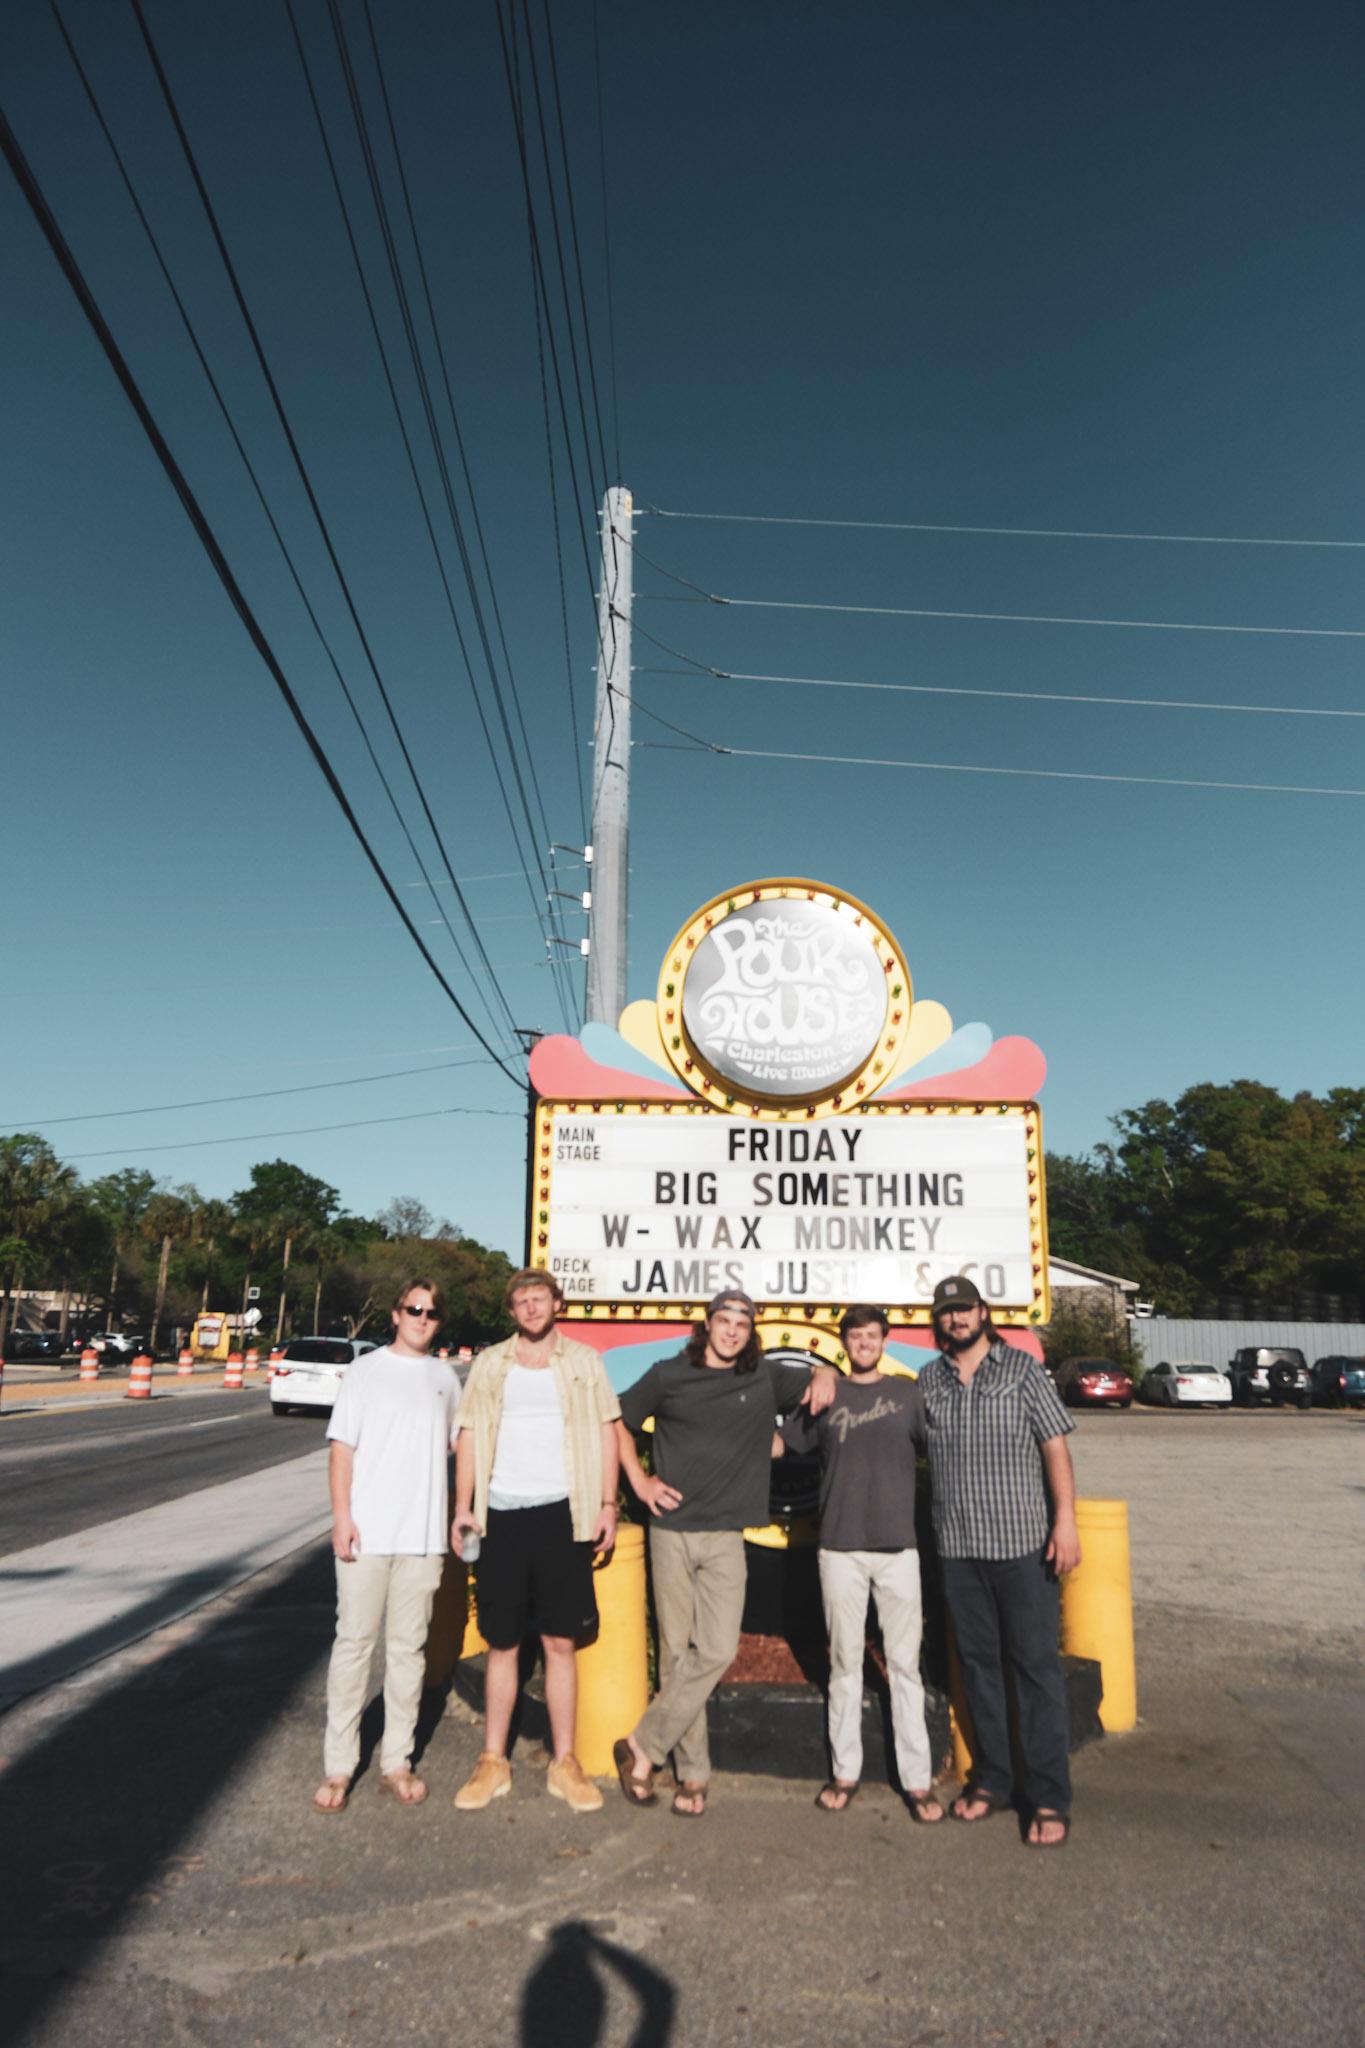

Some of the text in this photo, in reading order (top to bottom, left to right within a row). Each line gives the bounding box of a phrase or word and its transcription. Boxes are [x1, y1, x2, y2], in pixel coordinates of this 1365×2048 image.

[558, 1128, 595, 1142] MAIN
[728, 1128, 862, 1162] FRIDAY
[557, 1145, 600, 1160] STAGE
[655, 1172, 965, 1206] BIG SOMETHING
[675, 1215, 762, 1249] WAX
[794, 1215, 942, 1251] MONKEY
[553, 1258, 591, 1273] DECK
[622, 1259, 744, 1294] JAMES
[829, 1396, 897, 1443] Fender
